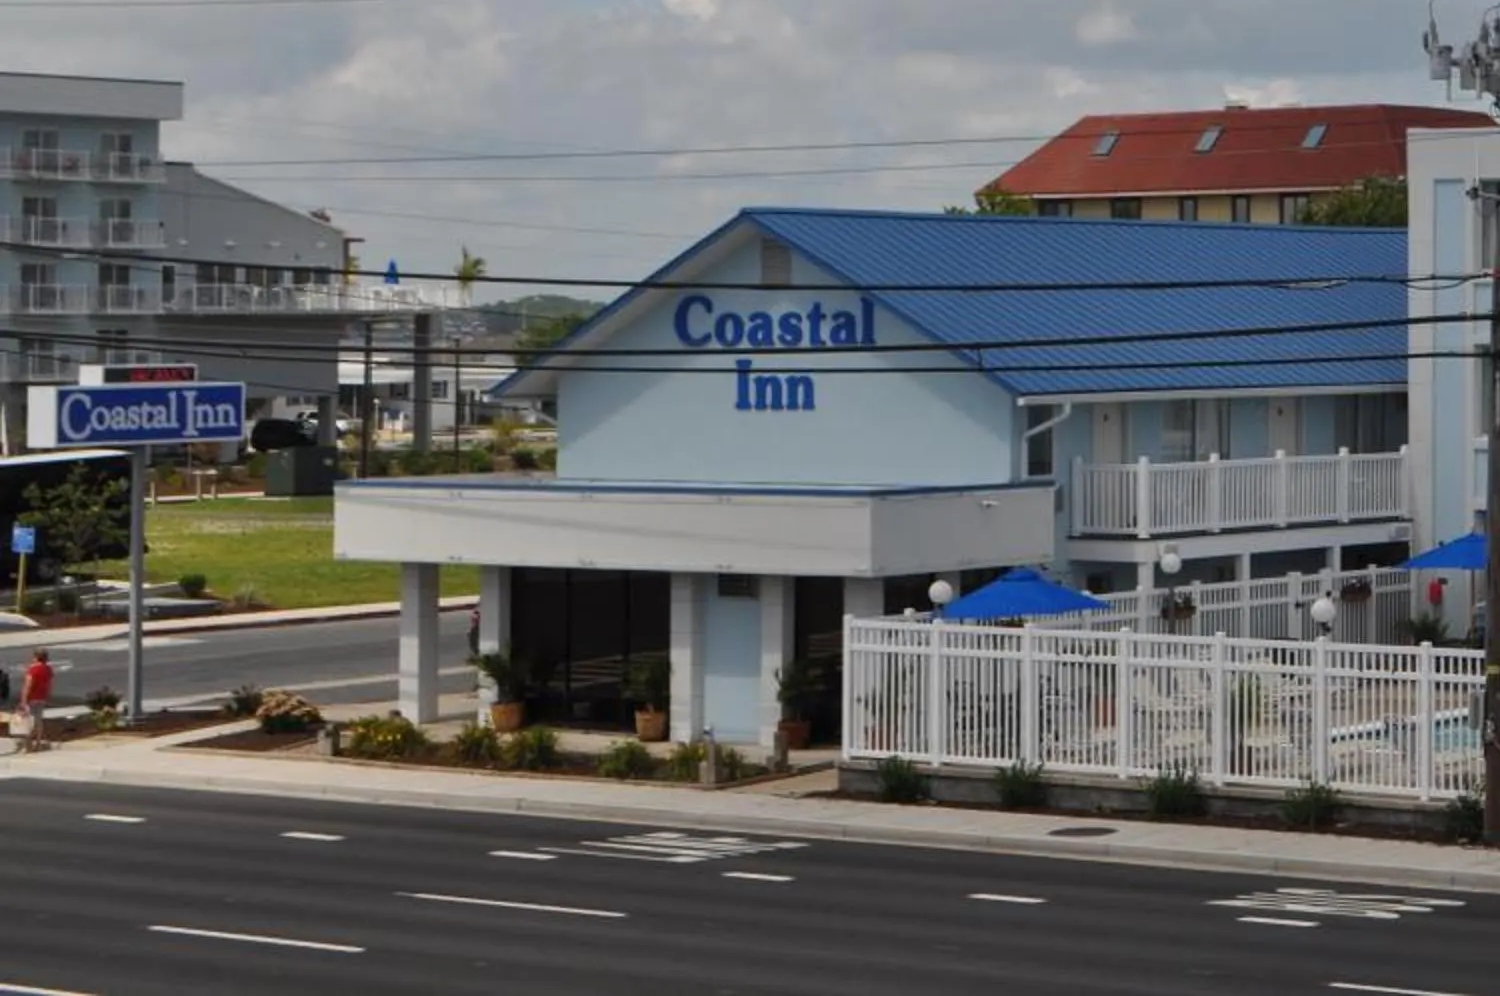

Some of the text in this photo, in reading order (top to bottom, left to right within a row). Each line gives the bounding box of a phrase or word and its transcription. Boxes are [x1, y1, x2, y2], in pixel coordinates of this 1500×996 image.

[673, 294, 877, 348] Coastal
[734, 359, 816, 411] Inn
[61, 390, 238, 441] Coastal Inn
